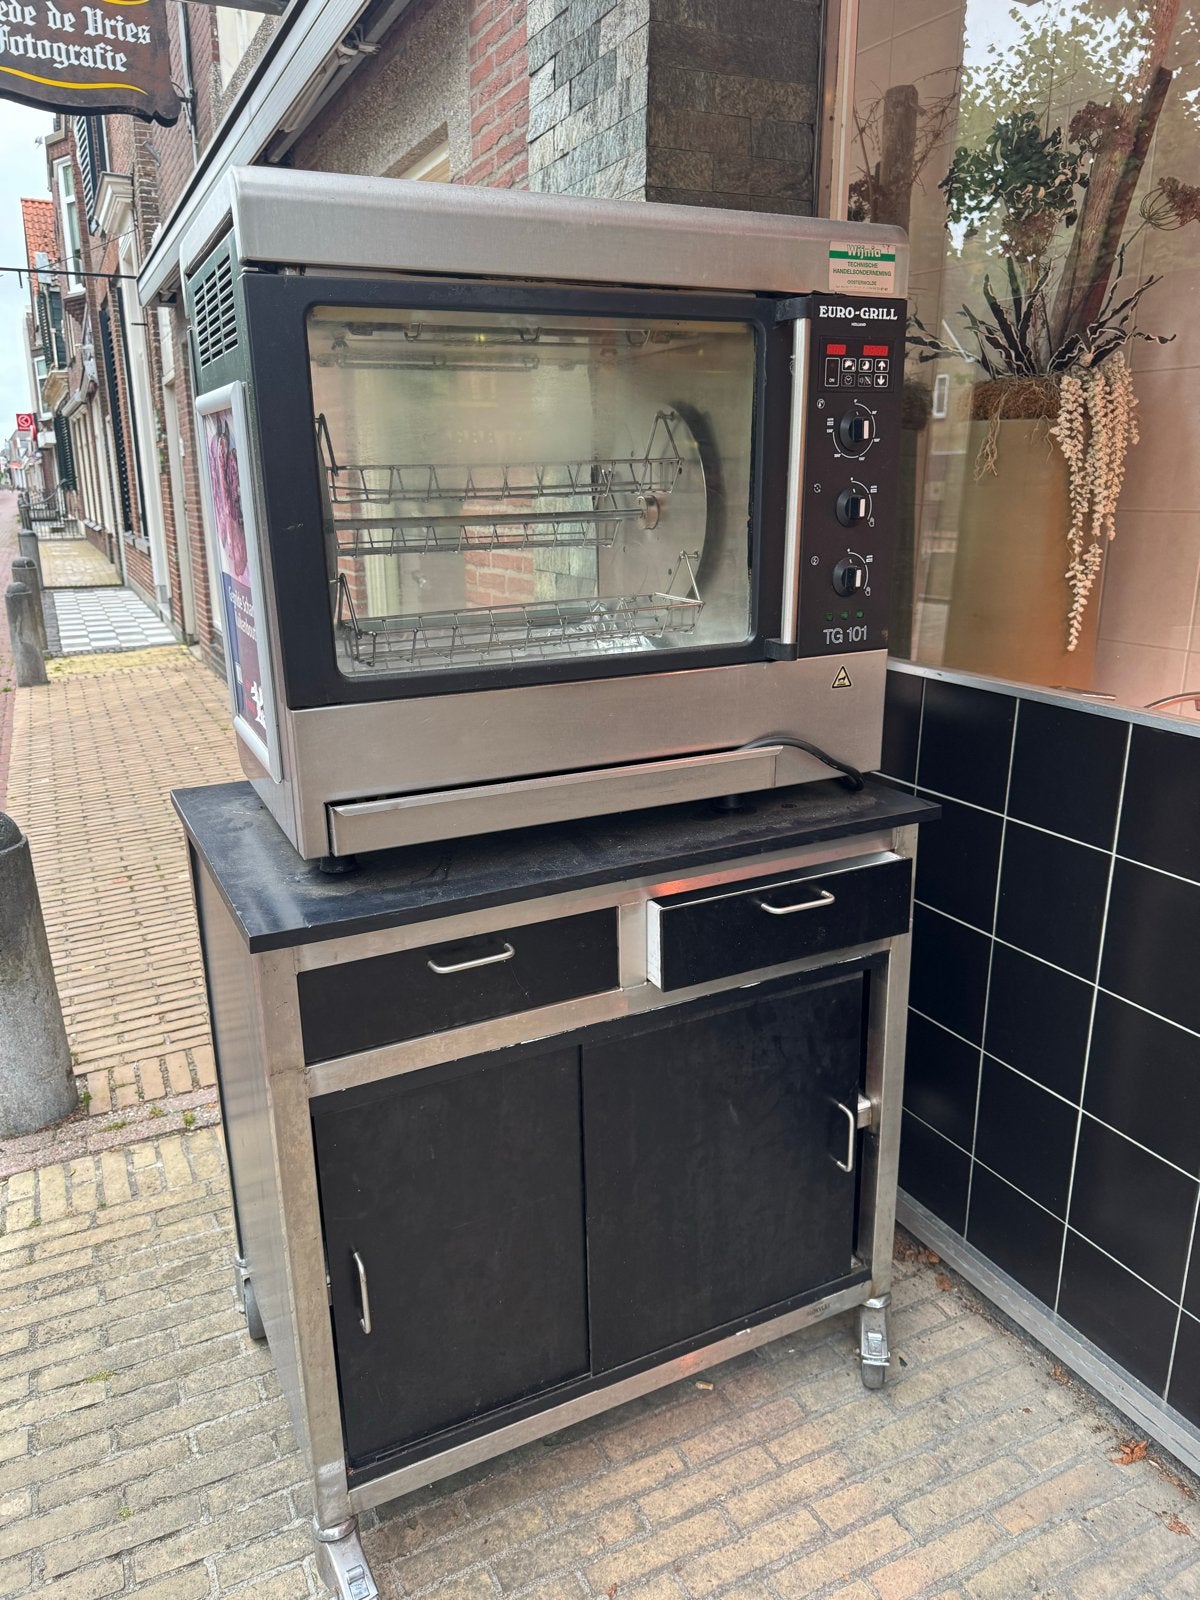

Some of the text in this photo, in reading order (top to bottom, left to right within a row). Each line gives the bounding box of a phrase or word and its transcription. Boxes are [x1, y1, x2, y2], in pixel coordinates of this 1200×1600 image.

[46, 0, 76, 32] de
[81, 6, 151, 44] Vries
[847, 244, 881, 259] Wijnia
[832, 268, 891, 276] HANDELSONDERNEMING
[819, 305, 898, 320] EURO-GRILL
[823, 625, 867, 644] TG 101
